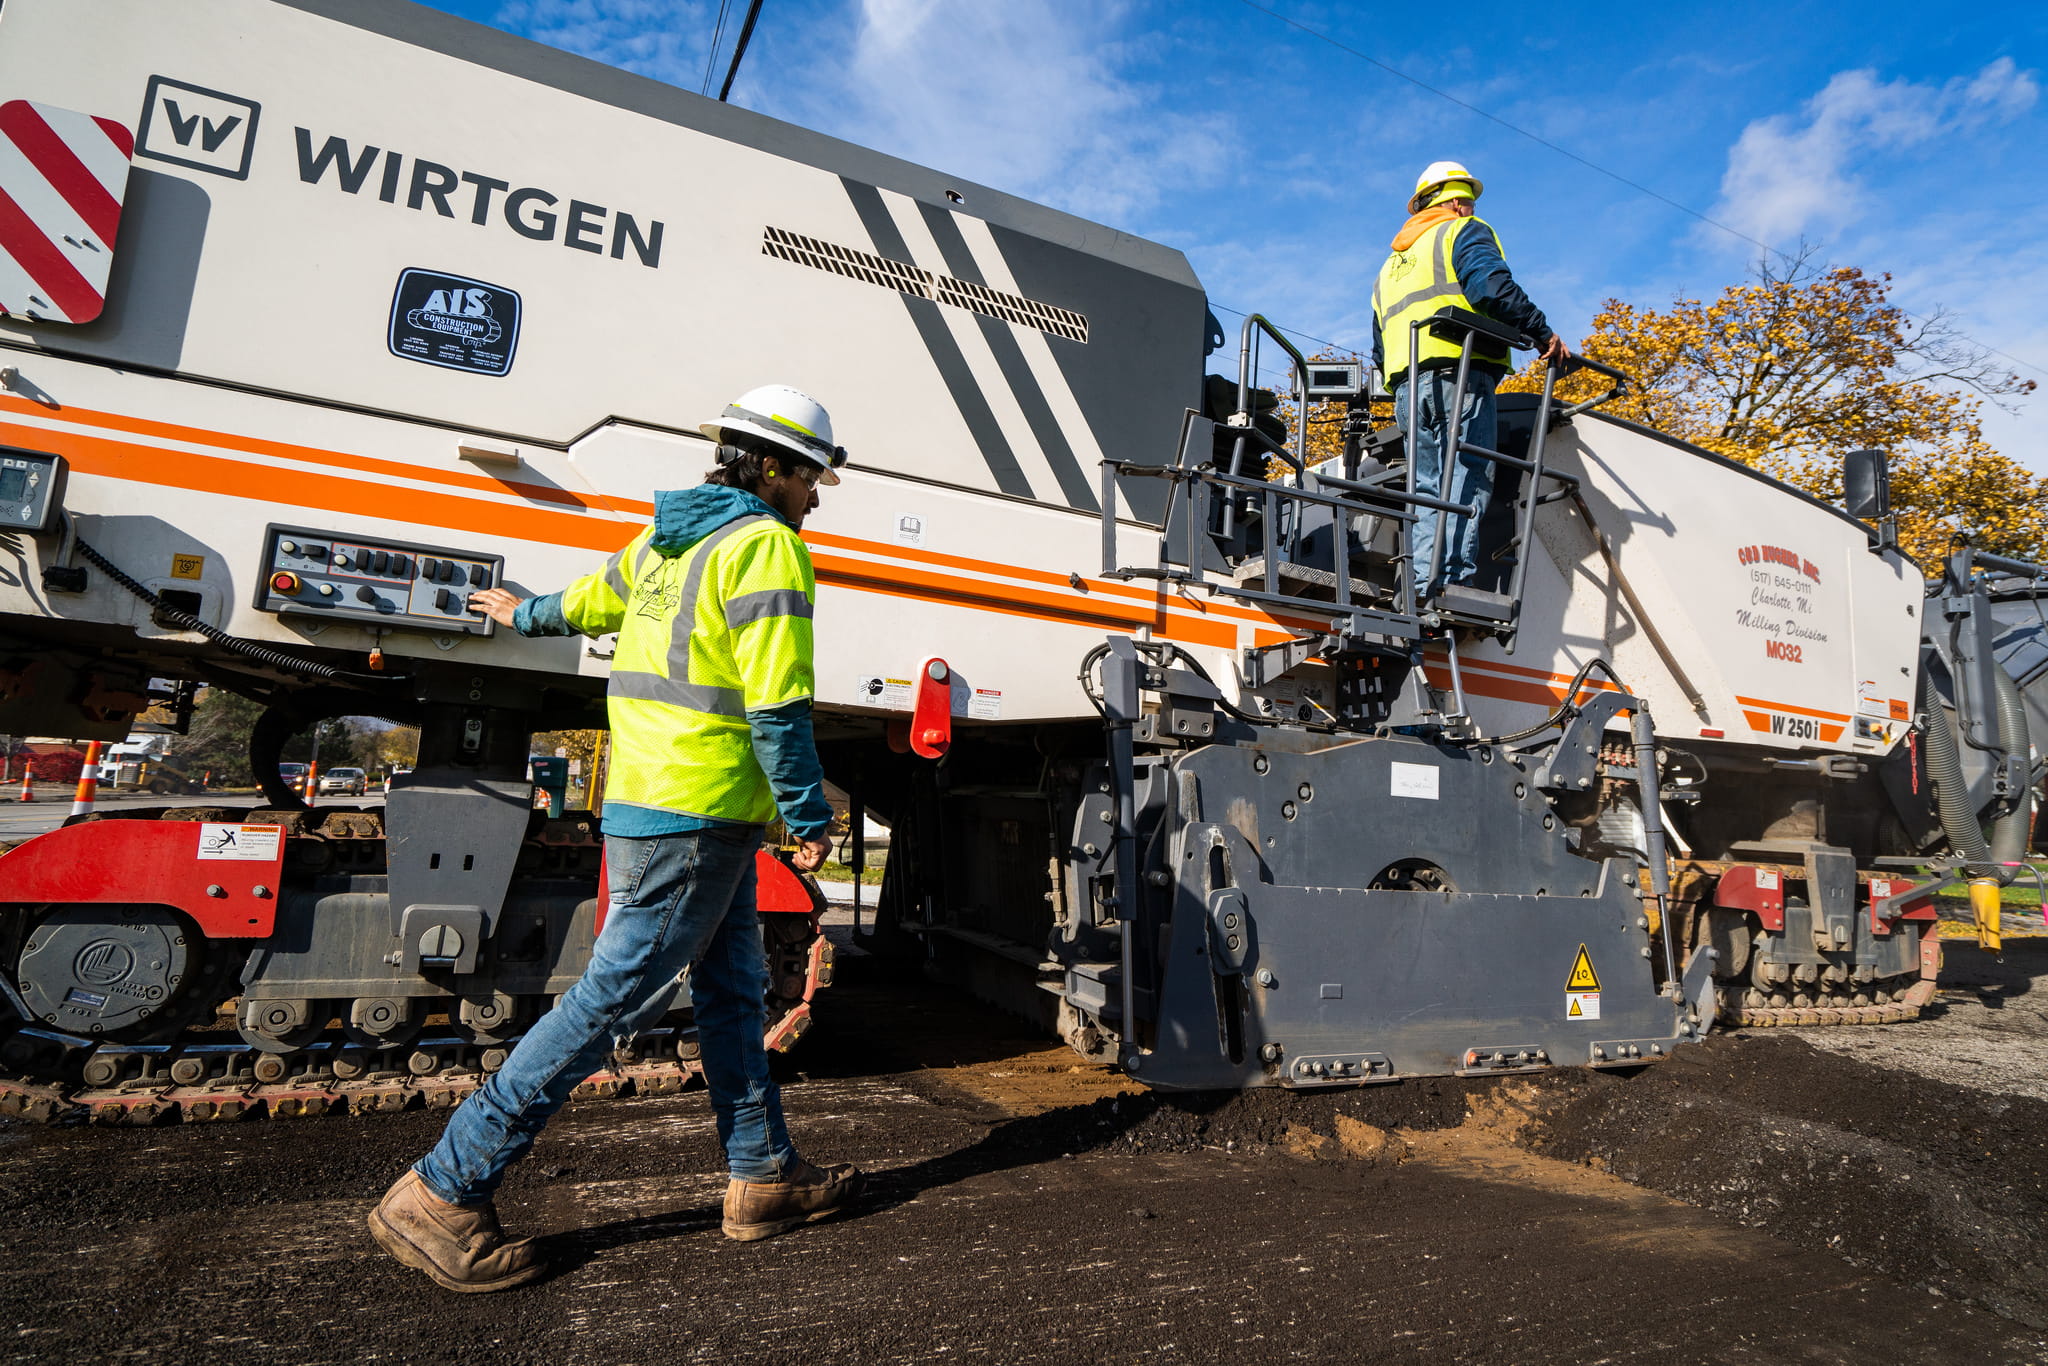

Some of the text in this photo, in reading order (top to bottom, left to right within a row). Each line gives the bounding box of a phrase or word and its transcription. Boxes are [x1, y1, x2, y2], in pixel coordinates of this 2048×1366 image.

[294, 126, 664, 269] WIRTGEN
[423, 288, 491, 317] AIS
[423, 313, 484, 332] CONSTRUCTION
[432, 322, 474, 336] EQUIPMENT
[1761, 545, 1801, 574] HUGHES,
[1803, 558, 1821, 585] INC.
[1751, 569, 1812, 594] (517) 645-0111
[1796, 596, 1813, 614] Mi
[1736, 609, 1828, 642] Milling Division
[1772, 715, 1785, 735] W
